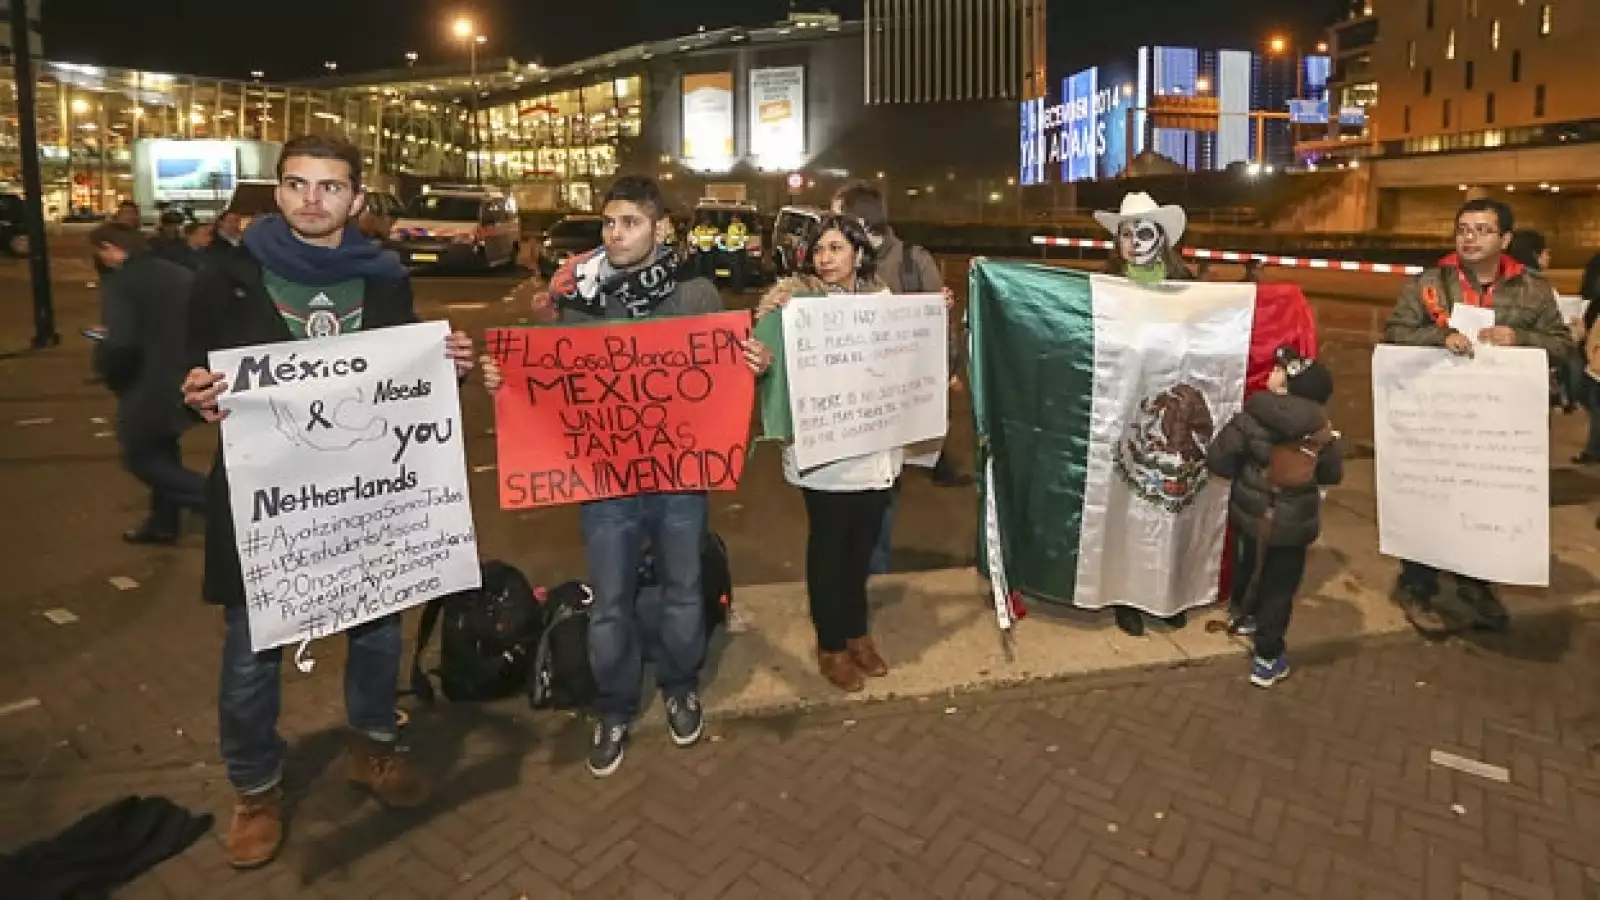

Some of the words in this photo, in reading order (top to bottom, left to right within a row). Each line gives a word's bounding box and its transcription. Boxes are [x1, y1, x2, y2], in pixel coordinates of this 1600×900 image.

[230, 353, 368, 393] México
[372, 378, 432, 405] Needs
[527, 367, 713, 406] MEXICO
[559, 404, 668, 432] UNIDO
[392, 417, 453, 464] you
[563, 421, 696, 460] JAMAS
[251, 463, 419, 523] Netherlands
[506, 464, 592, 504] SERA
